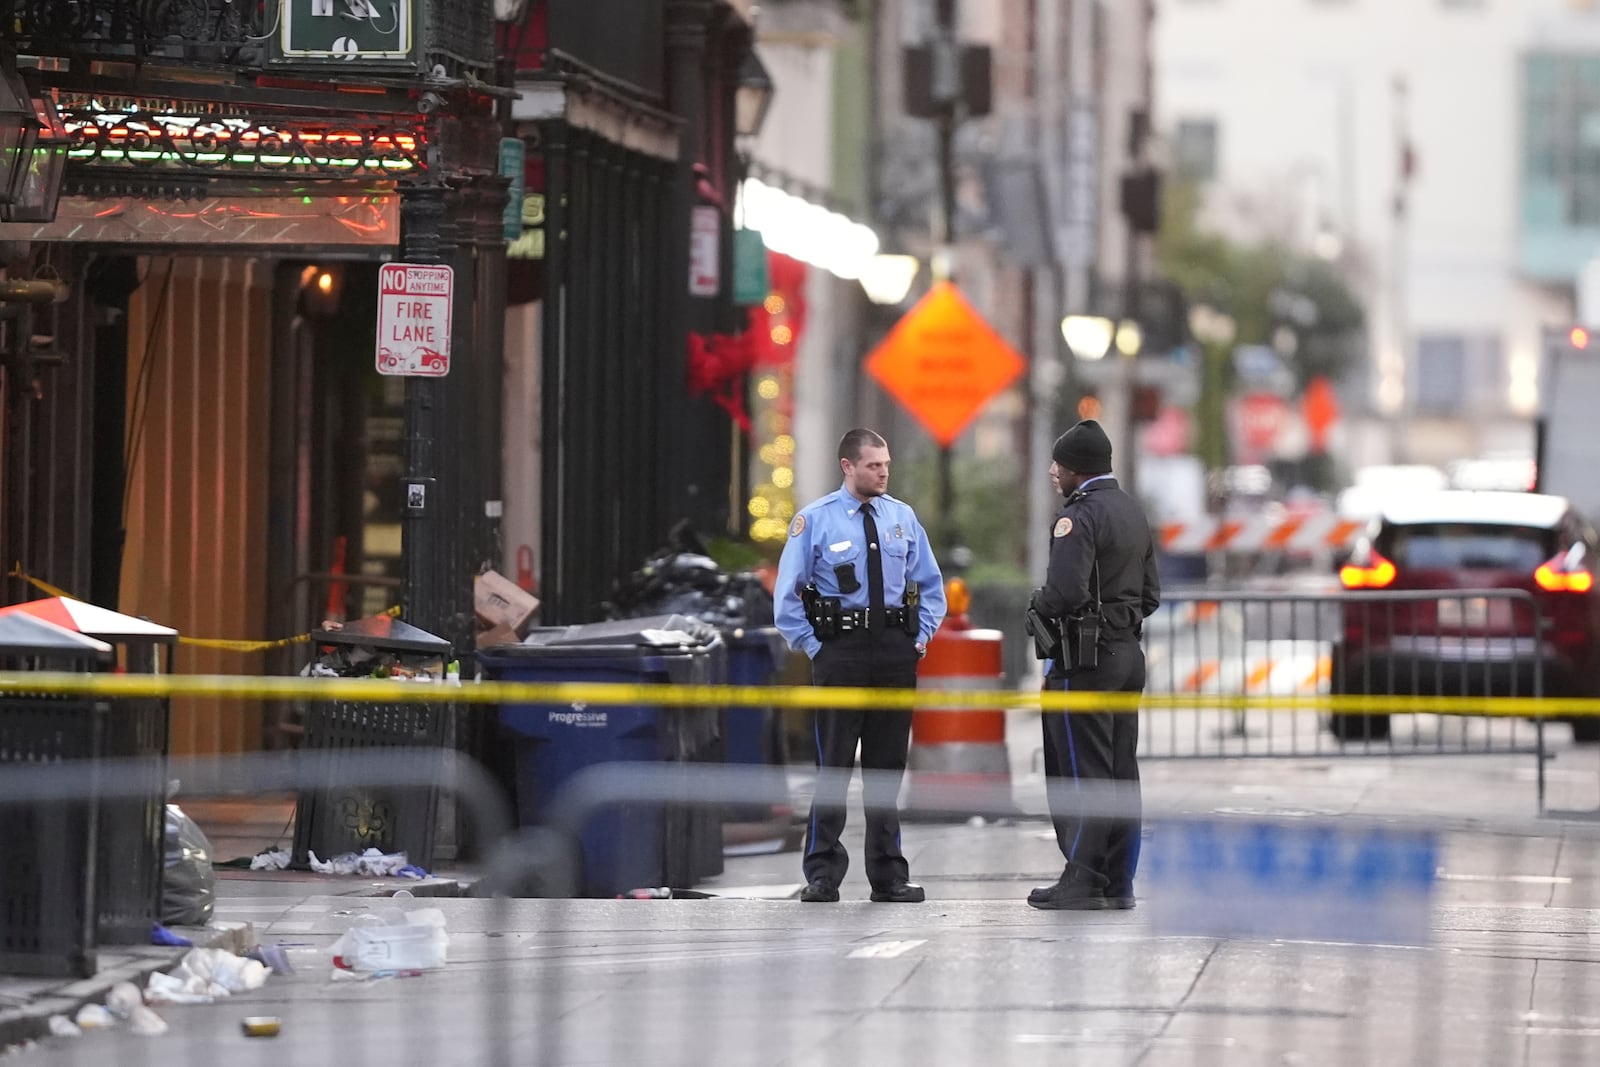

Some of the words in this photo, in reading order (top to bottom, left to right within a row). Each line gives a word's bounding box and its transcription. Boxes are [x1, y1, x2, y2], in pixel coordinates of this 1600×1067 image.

[383, 270, 406, 291] NO
[408, 271, 448, 280] STOPPING
[410, 282, 446, 292] ANYTIME
[397, 302, 432, 319] FIRE
[393, 325, 435, 342] LANE
[548, 711, 608, 724] Progressive
